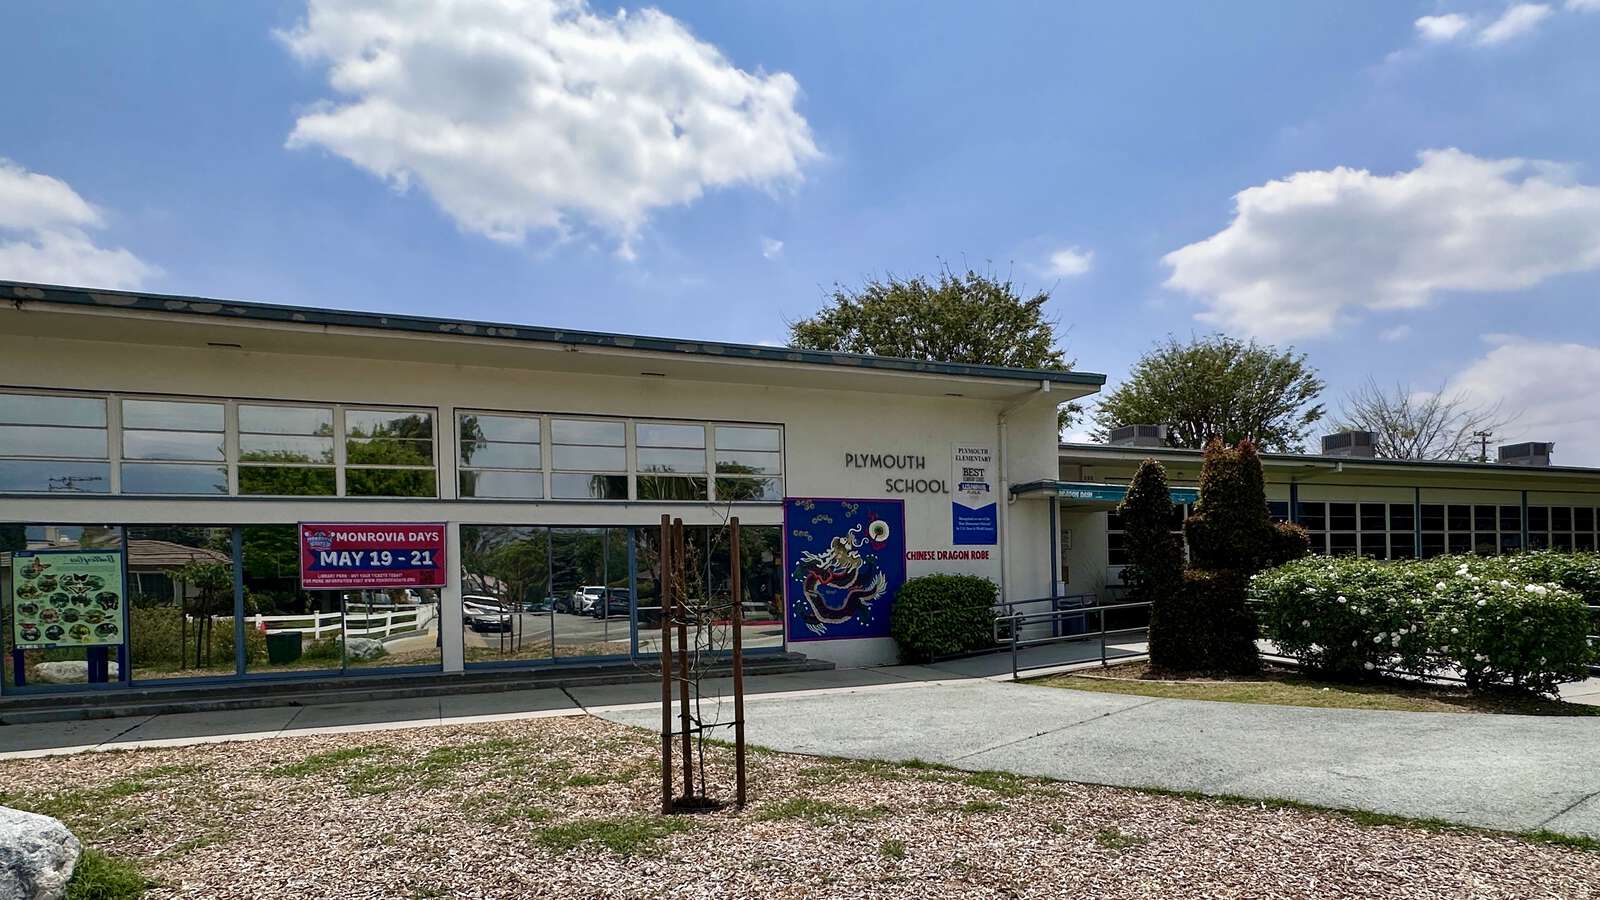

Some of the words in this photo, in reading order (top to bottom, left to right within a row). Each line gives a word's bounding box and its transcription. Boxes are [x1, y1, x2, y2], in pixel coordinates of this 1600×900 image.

[958, 447, 989, 455] PLYMOUTH
[845, 453, 925, 469] PLYMOUTH
[963, 467, 985, 477] BEST
[885, 479, 949, 494] SCHOOL
[336, 532, 405, 542] MONROVIA
[408, 532, 440, 541] DAYS
[320, 551, 364, 566] MAY
[370, 551, 393, 566] 19
[411, 550, 433, 565] 21
[906, 551, 935, 560] CHINESE
[937, 551, 969, 560] DRAGON
[971, 550, 990, 559] ROBE
